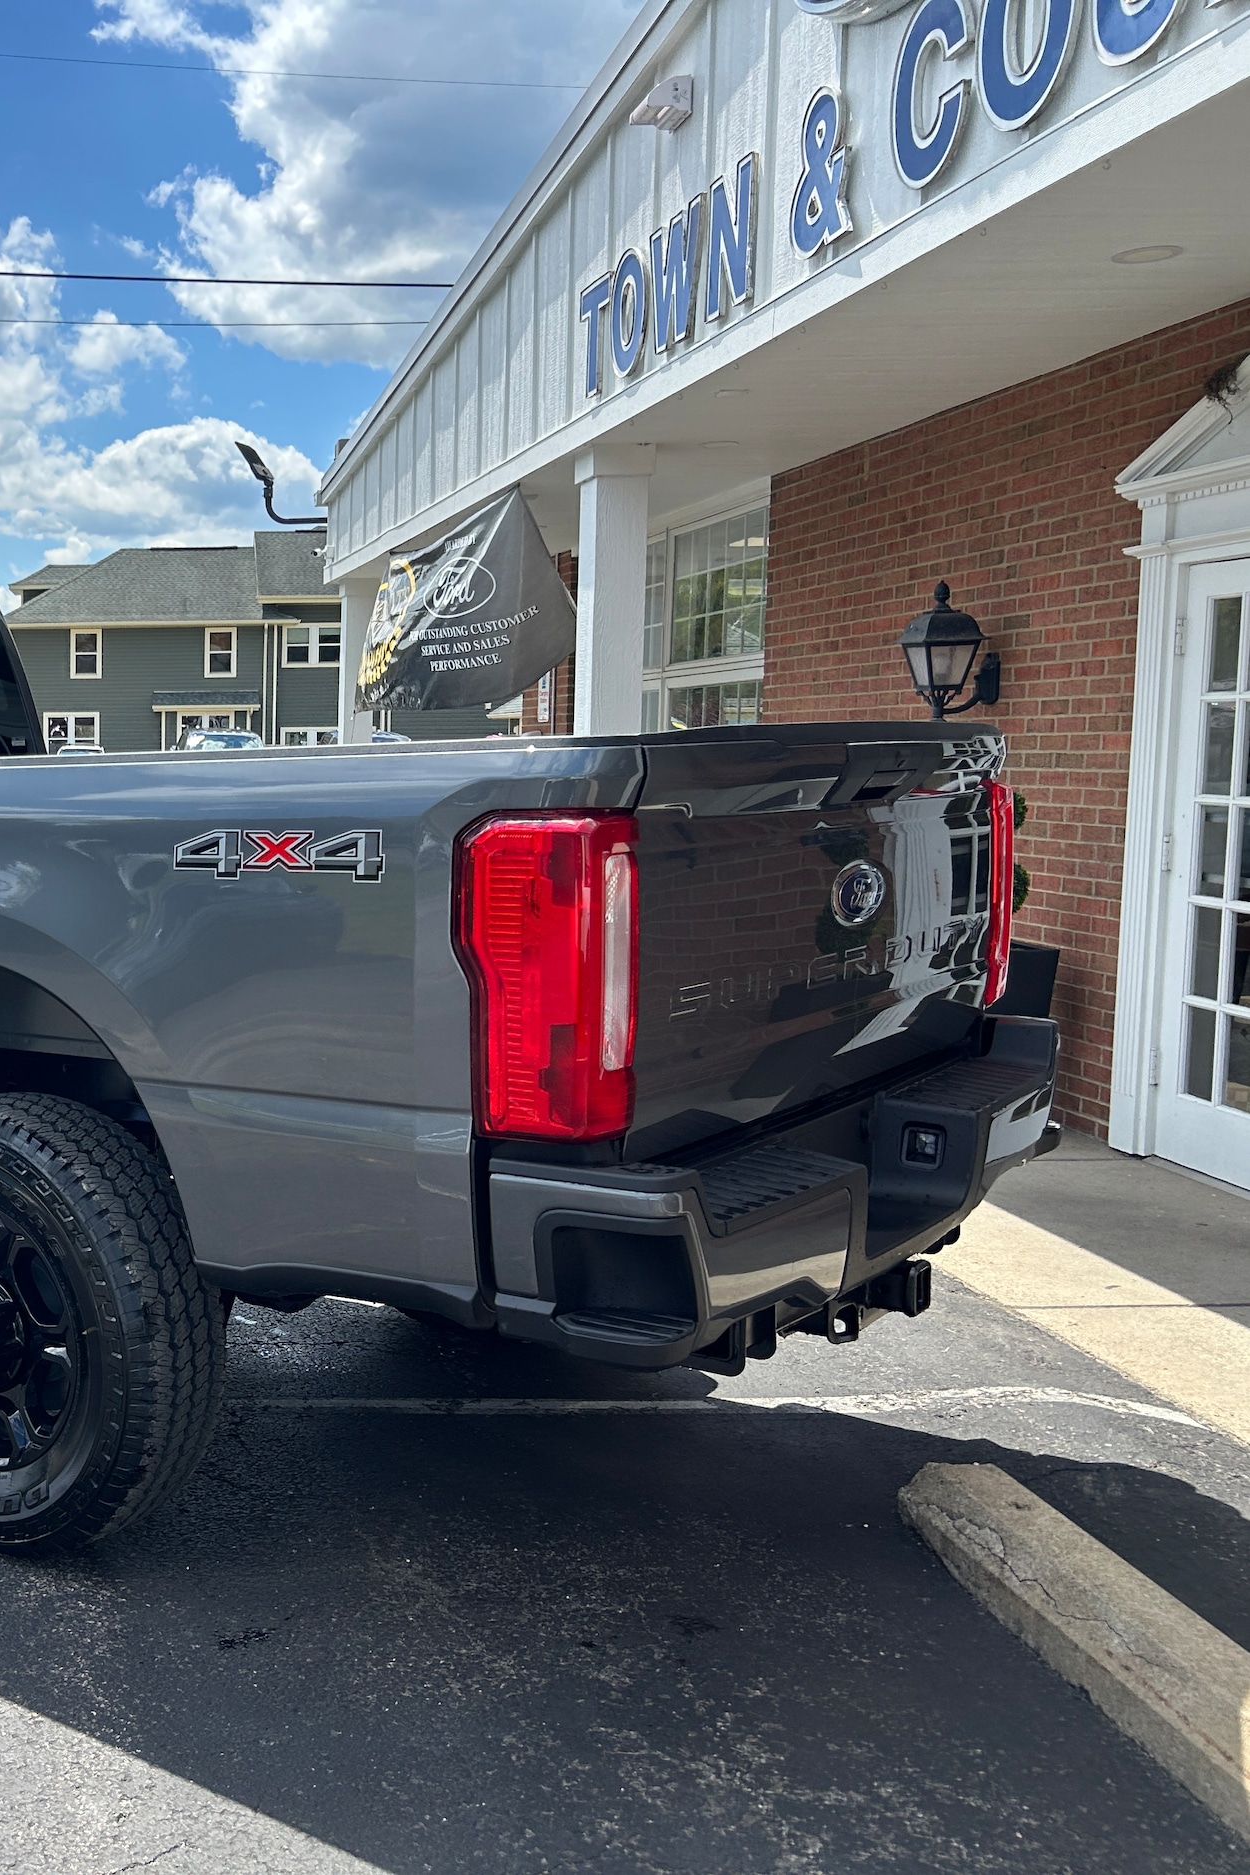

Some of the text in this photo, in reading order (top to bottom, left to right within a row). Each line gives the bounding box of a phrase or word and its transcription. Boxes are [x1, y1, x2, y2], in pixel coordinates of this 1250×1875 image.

[580, 0, 1185, 398] TOWN & CO
[433, 566, 475, 608] Ford
[419, 625, 468, 641] OUTSTANDING
[470, 605, 539, 635] CUSTOMER
[421, 634, 510, 656] SERVICE AND SALES
[430, 653, 502, 672] PERFORMANCE
[669, 914, 988, 1023] SUPER DUTY
